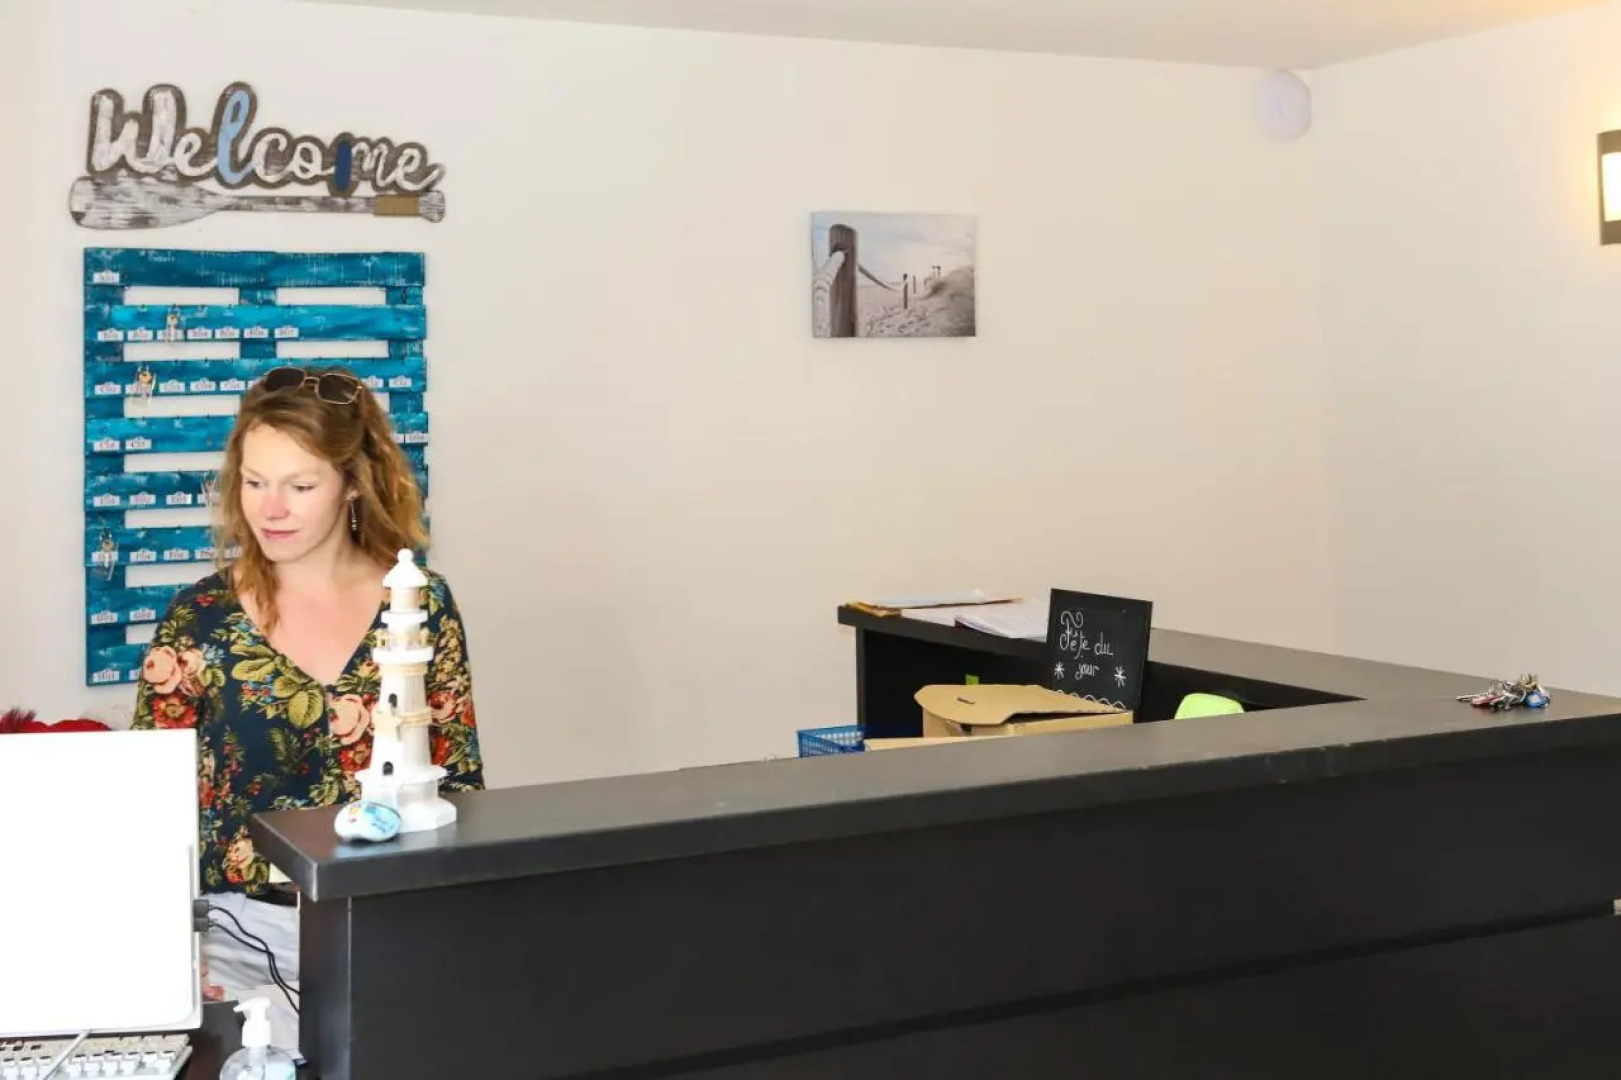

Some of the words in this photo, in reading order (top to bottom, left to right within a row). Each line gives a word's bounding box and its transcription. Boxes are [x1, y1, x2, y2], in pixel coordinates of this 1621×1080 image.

[90, 85, 444, 195] Welcome
[1094, 630, 1114, 656] du
[1075, 654, 1100, 680] jour
